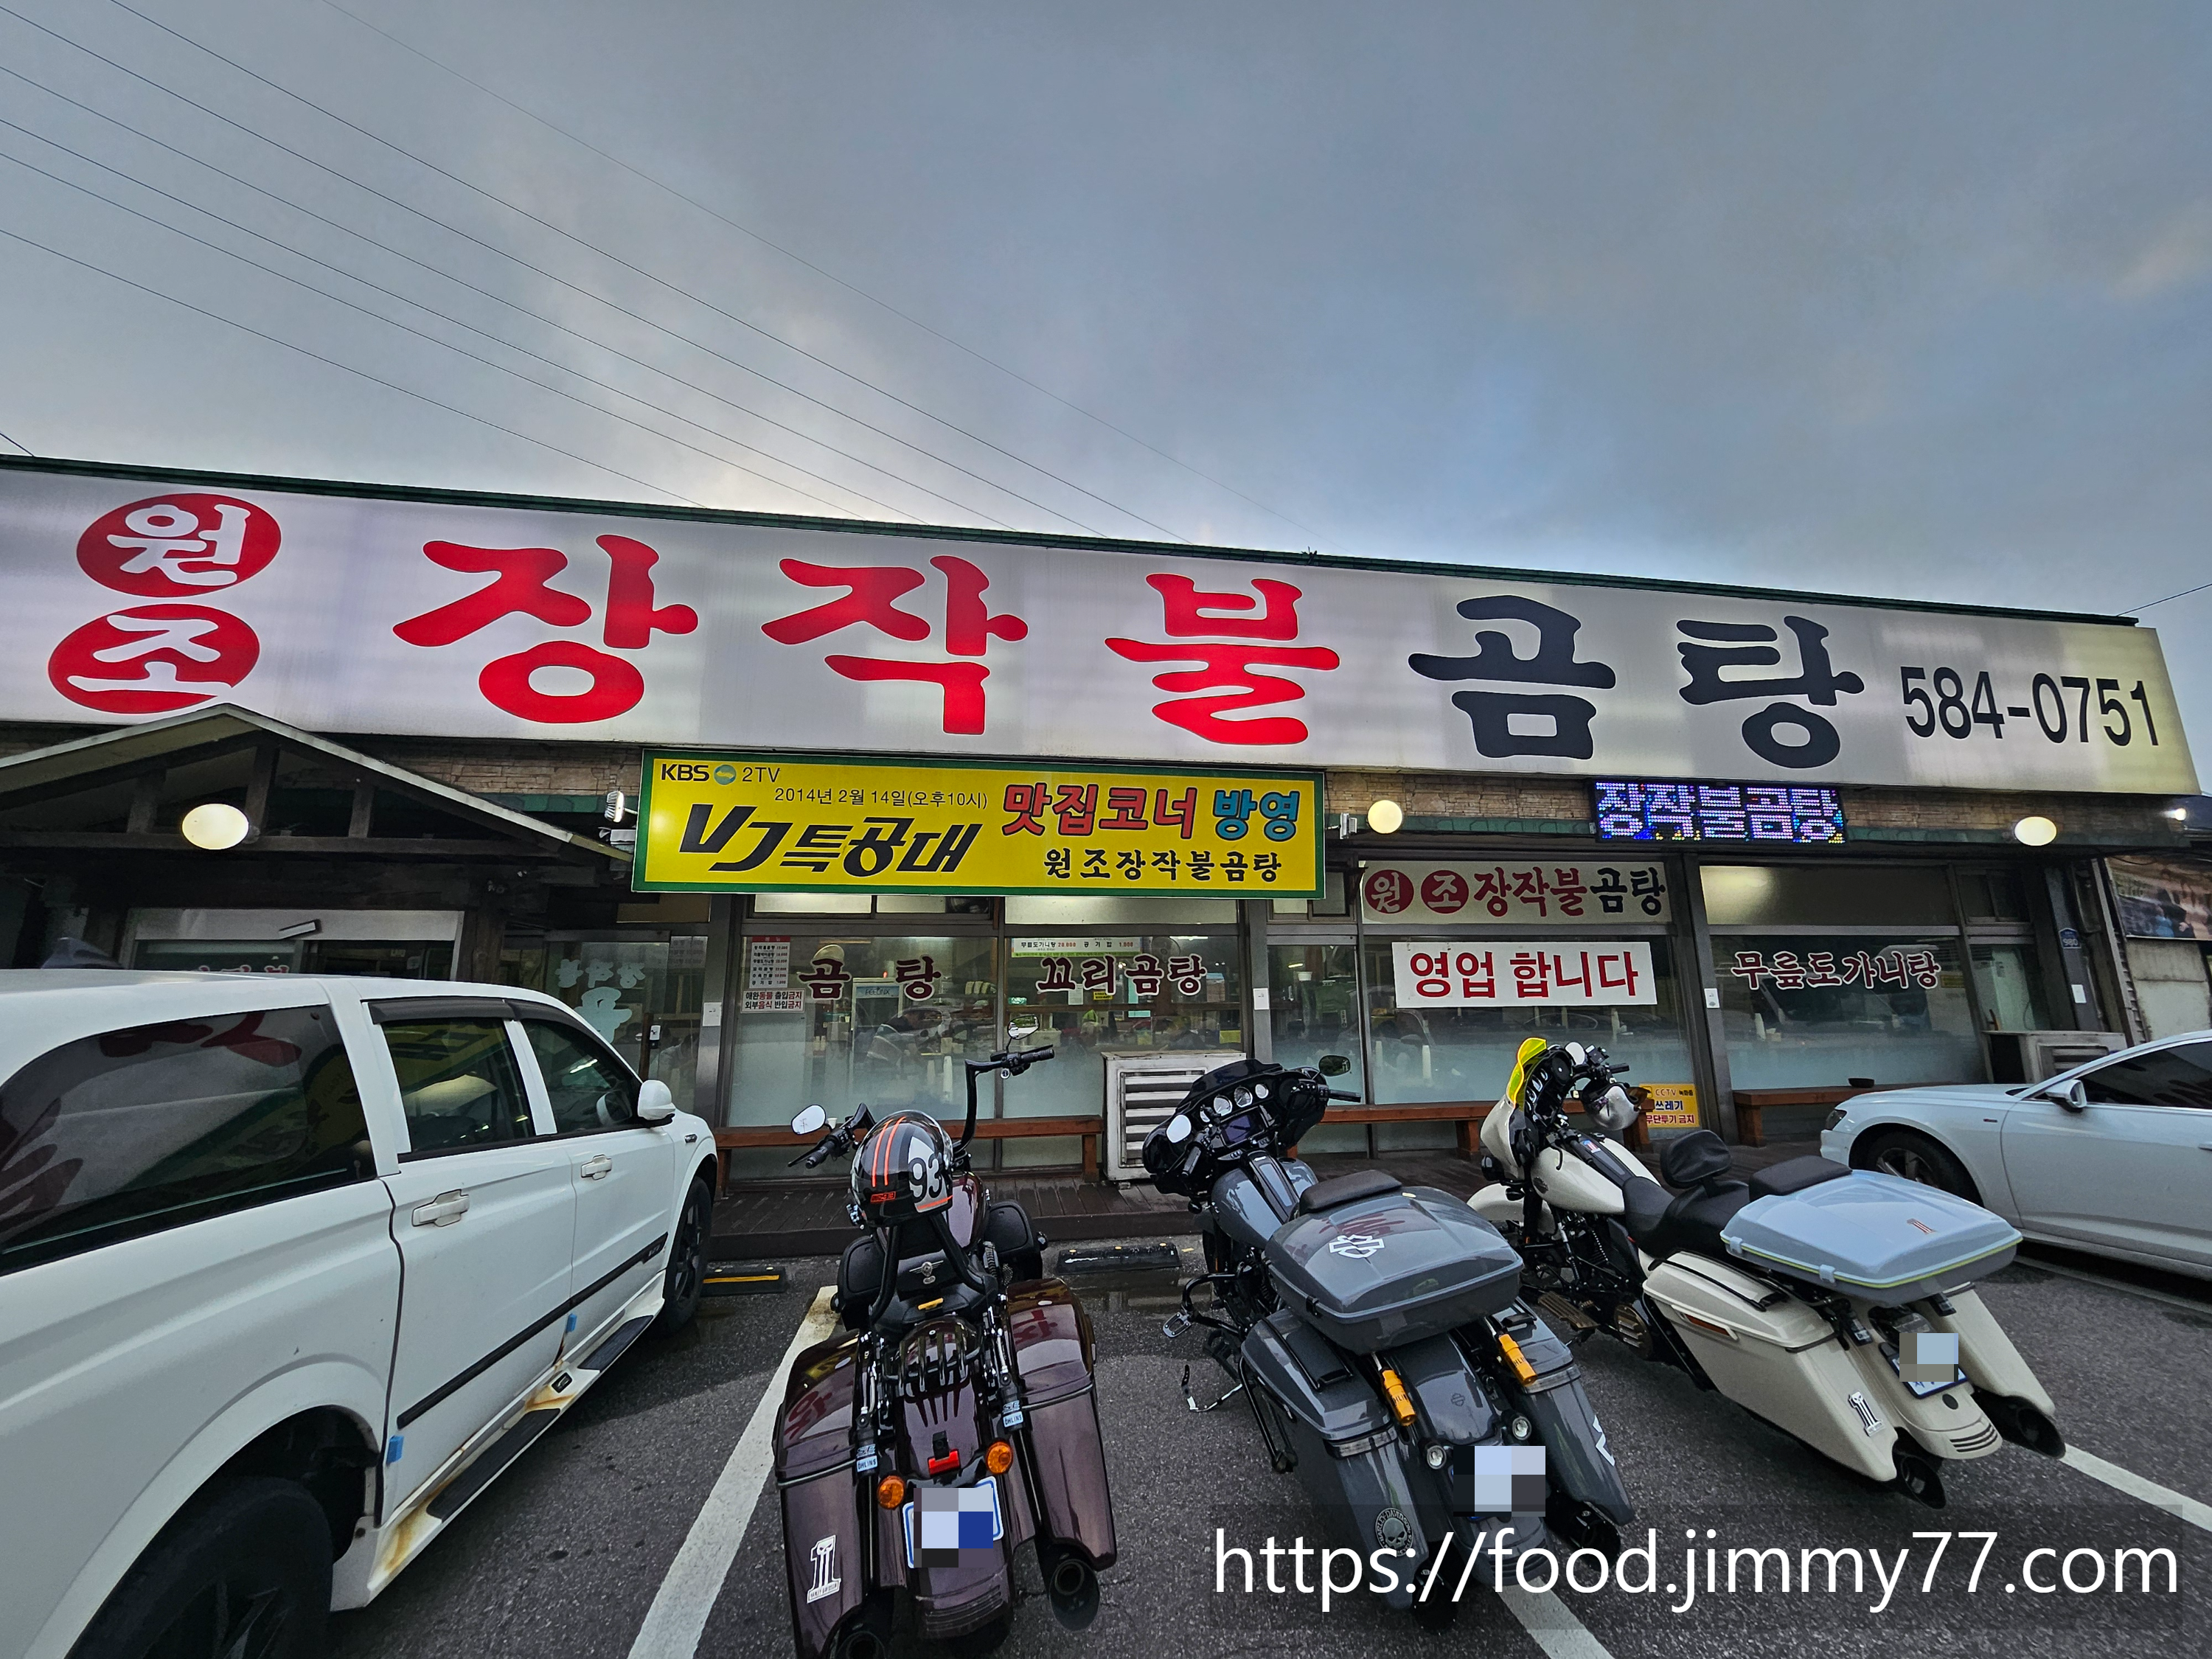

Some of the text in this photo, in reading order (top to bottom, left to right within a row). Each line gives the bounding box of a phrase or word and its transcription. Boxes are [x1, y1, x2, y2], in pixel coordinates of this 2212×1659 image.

[1901, 667, 2159, 745] 584-0751
[661, 764, 780, 783] KBS 2TV
[774, 787, 832, 805] 2014년
[838, 789, 865, 806] 2월
[1001, 782, 1301, 841] 맛집코너 방영
[1595, 782, 1842, 840] 장작불곰탕
[1043, 847, 1283, 883] 원조장작불곰탕
[1037, 954, 1207, 995] 꼬리곰탕
[1409, 951, 1639, 998] 영업 합니다
[1732, 951, 1941, 990] 무릎도가니탕
[745, 991, 802, 1000] 애완동물 출입금지
[745, 1001, 801, 1009] 외부음식 반입금지
[1655, 1088, 1676, 1096] CCTV
[1655, 1100, 1684, 1111] 쓰레기
[1678, 1114, 1695, 1124] 금지
[907, 1152, 942, 1203] 93
